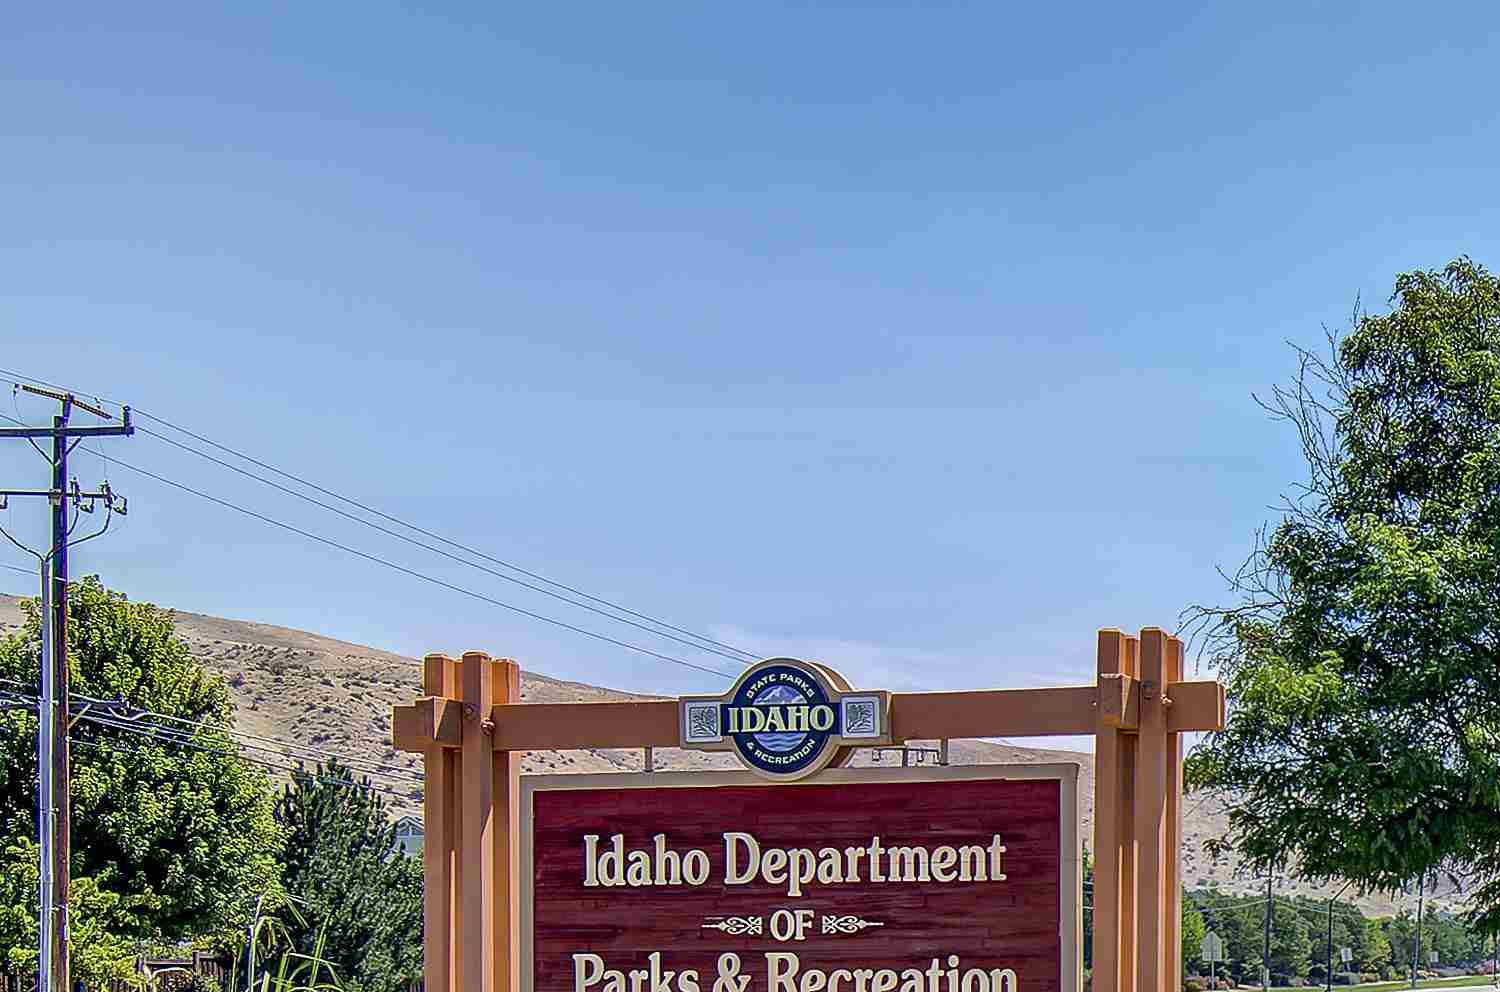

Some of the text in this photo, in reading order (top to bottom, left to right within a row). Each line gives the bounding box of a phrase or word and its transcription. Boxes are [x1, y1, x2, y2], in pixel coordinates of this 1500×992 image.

[746, 673, 814, 698] STATE PARKS
[728, 705, 834, 733] IDAHO
[754, 739, 816, 764] RECREATION
[583, 832, 1007, 897] Idaho Department
[769, 909, 815, 941] OF
